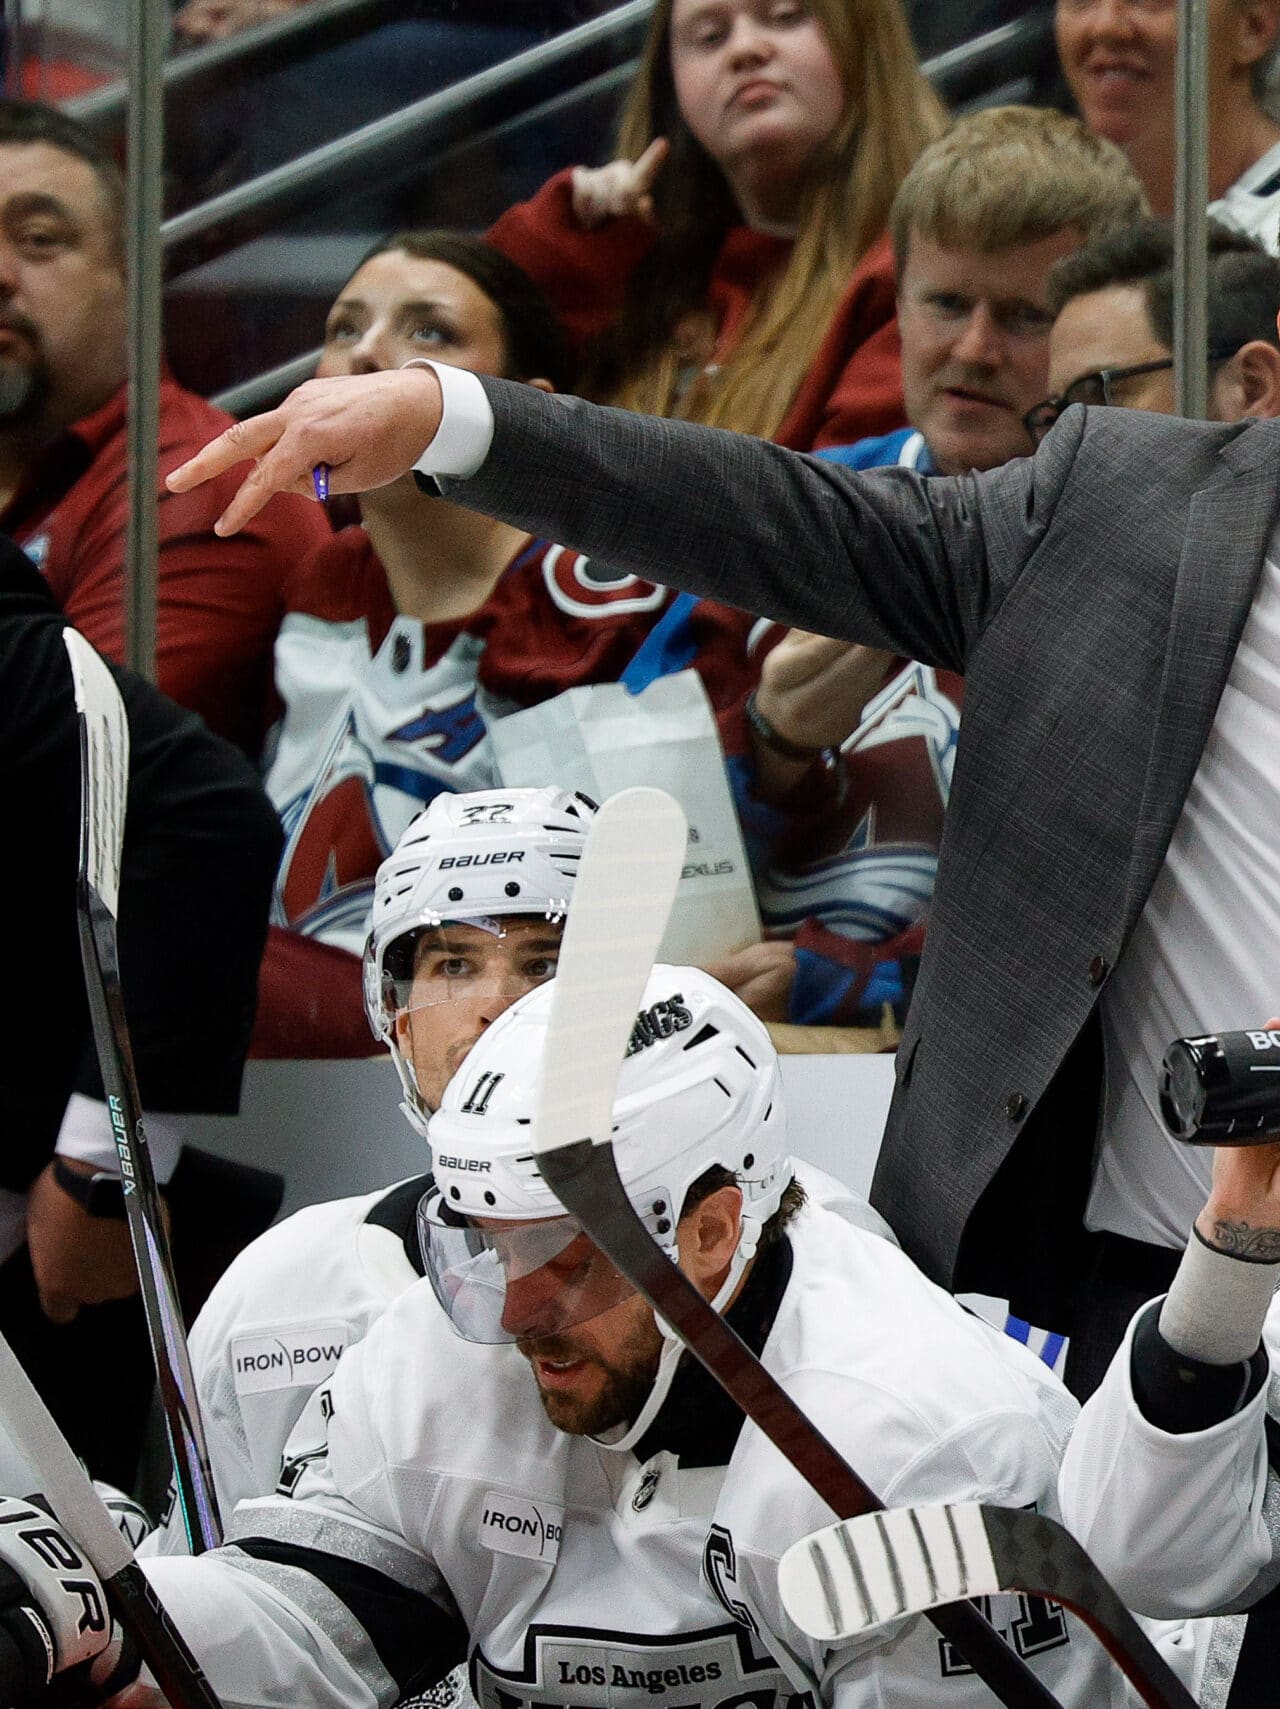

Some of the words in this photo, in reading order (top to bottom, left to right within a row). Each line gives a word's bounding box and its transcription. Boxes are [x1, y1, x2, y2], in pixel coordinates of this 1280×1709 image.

[438, 850, 526, 871] BAUER
[460, 1071, 505, 1116] 11
[438, 1154, 492, 1174] BAUER
[236, 1351, 284, 1373] IRON
[293, 1345, 344, 1365] BOW
[482, 1509, 539, 1537] IRON
[545, 1522, 563, 1542] BO
[558, 1660, 606, 1686] Los
[610, 1660, 722, 1694] Angeles
